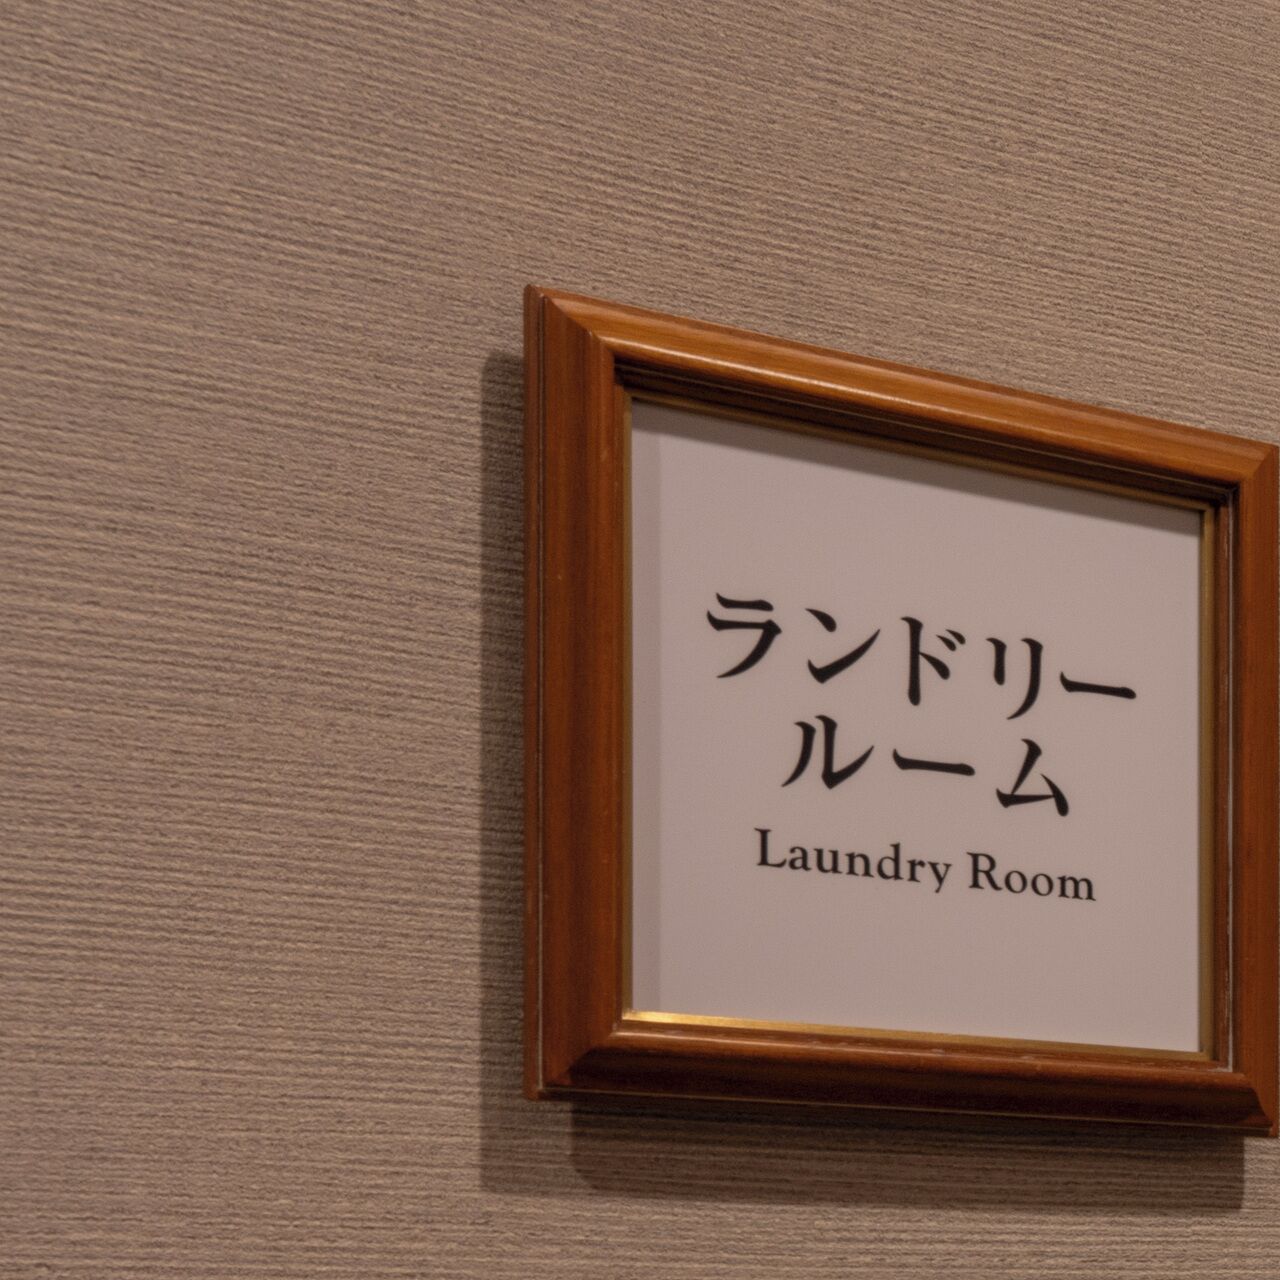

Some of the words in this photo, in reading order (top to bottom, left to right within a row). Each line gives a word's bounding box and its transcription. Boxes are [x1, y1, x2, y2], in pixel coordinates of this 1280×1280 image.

[706, 591, 1138, 721] ランドリー
[780, 714, 1070, 818] ルーム
[754, 827, 953, 894] Laundry
[967, 851, 1098, 902] Room
